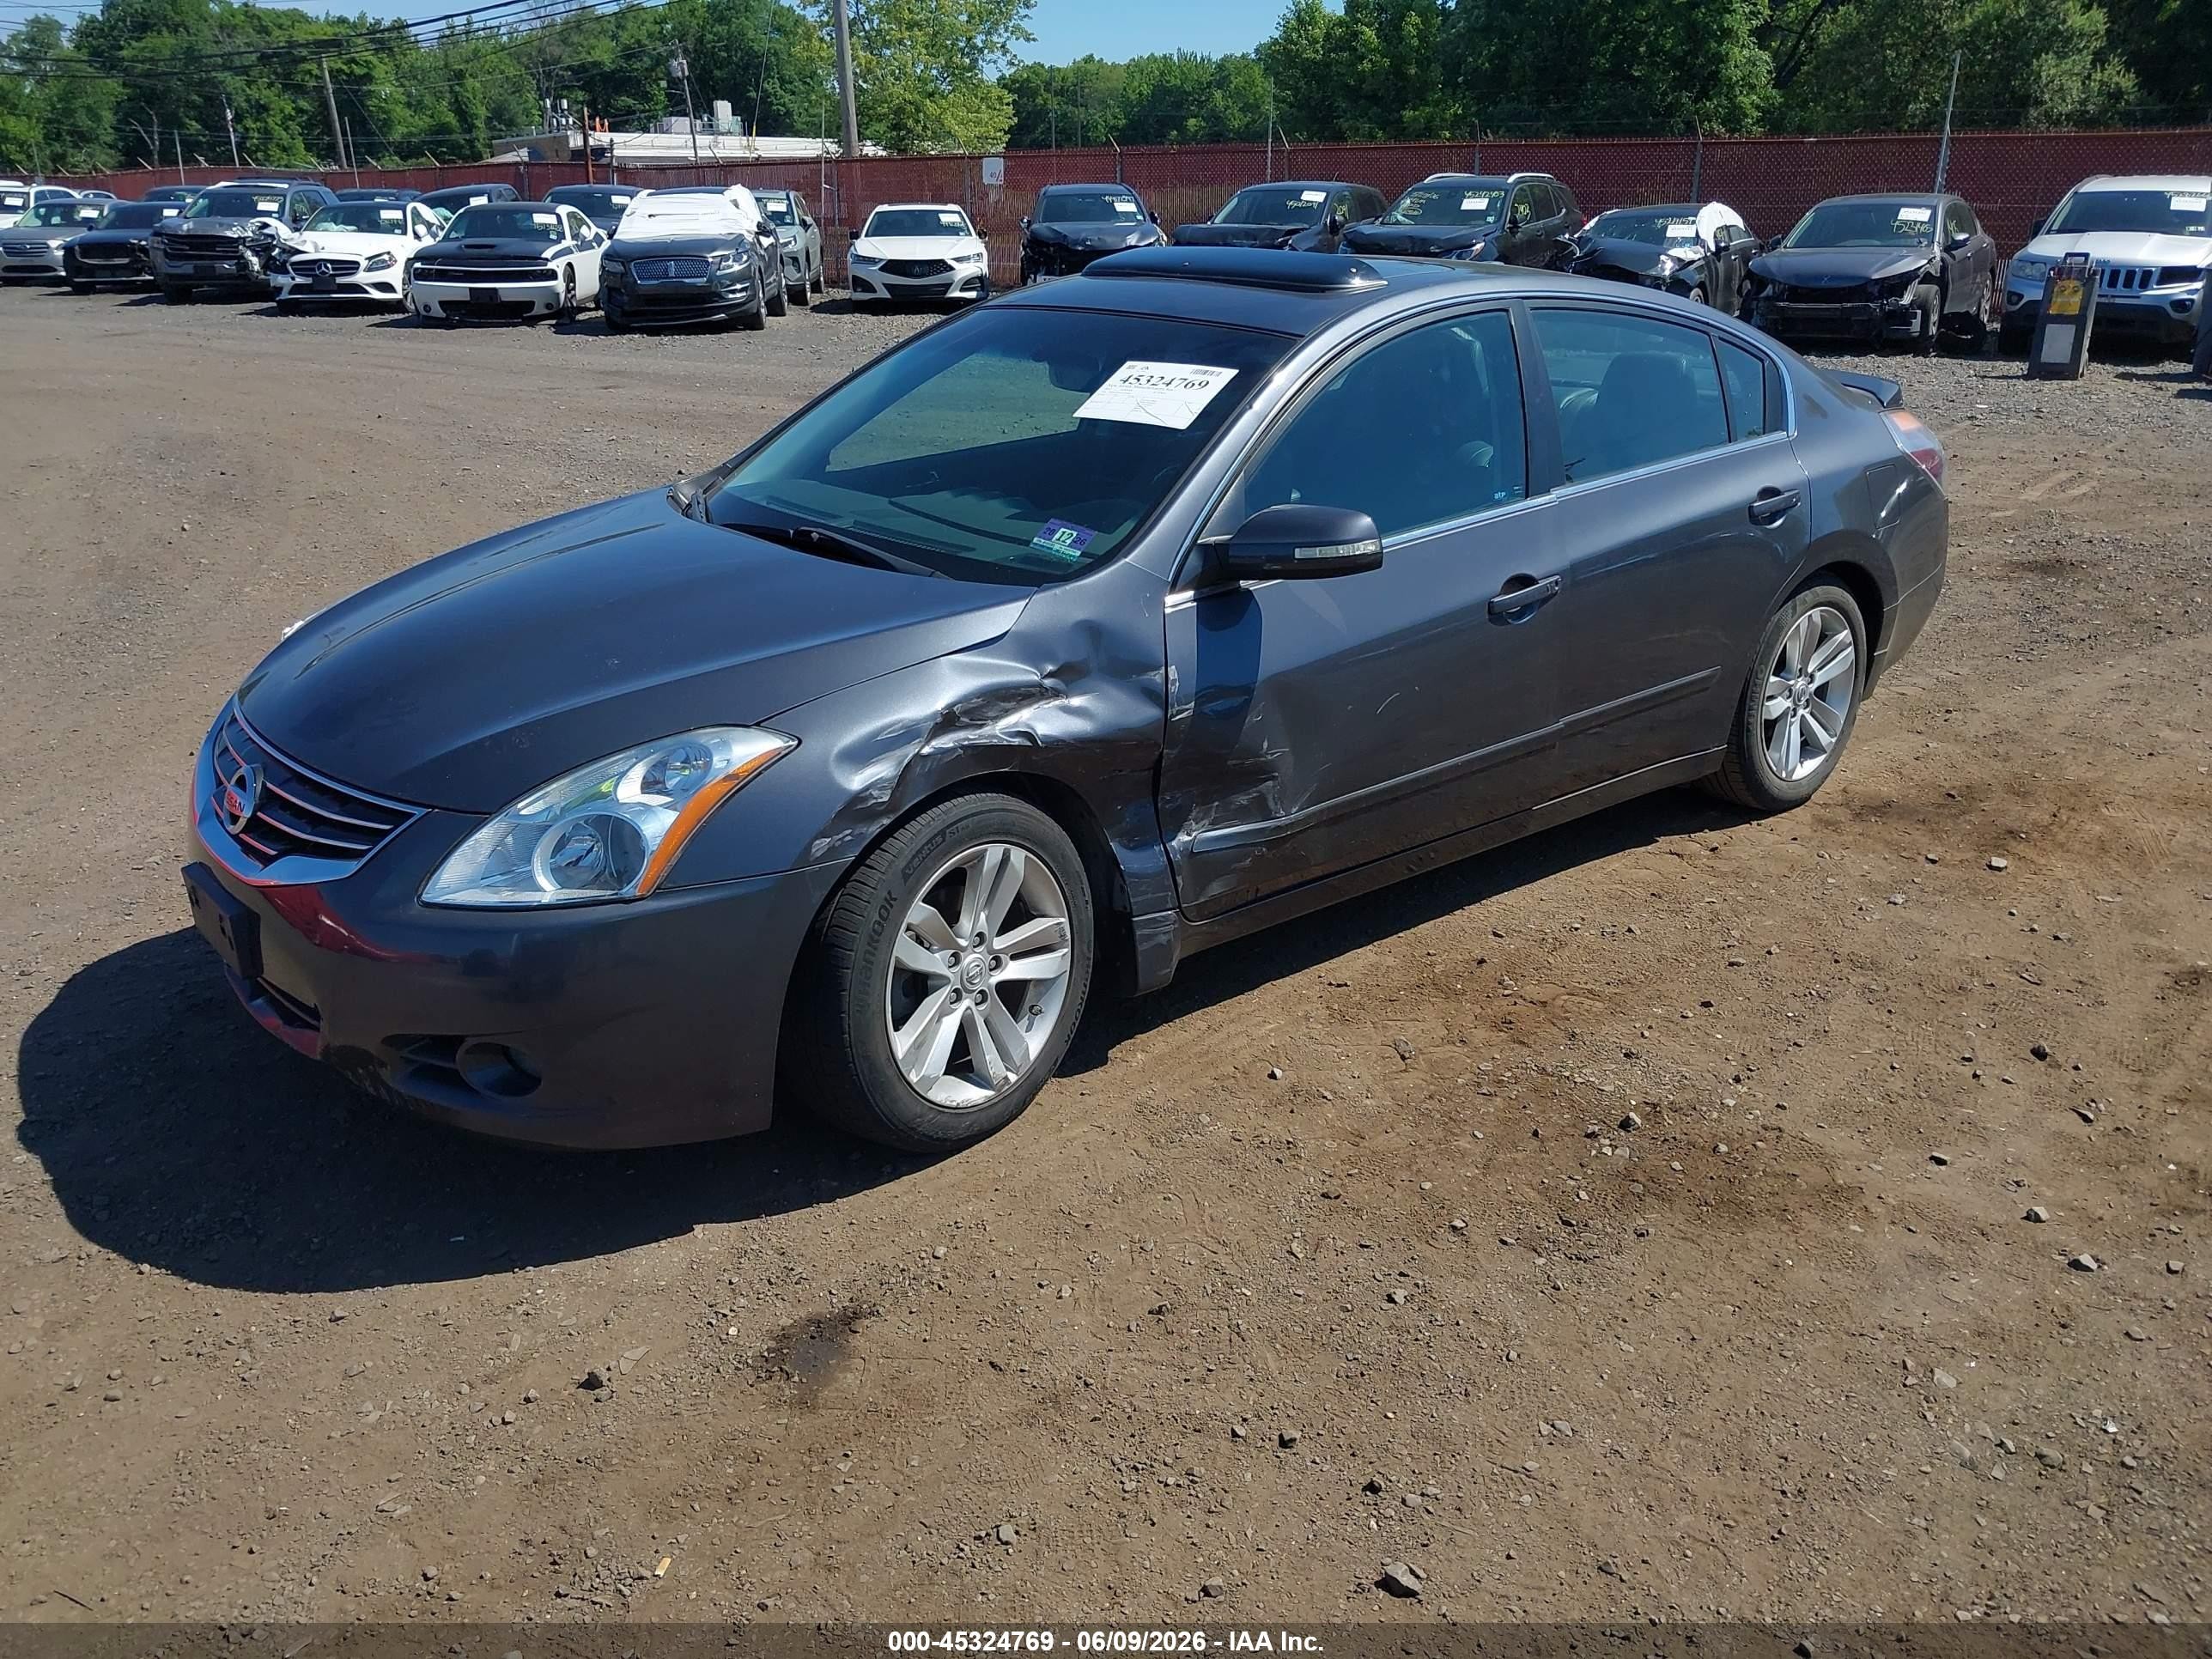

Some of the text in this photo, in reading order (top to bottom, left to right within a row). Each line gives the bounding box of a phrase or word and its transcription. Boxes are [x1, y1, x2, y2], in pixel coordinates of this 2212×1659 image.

[1120, 374, 1210, 391] 45324769
[1043, 526, 1087, 546] 20 12 26
